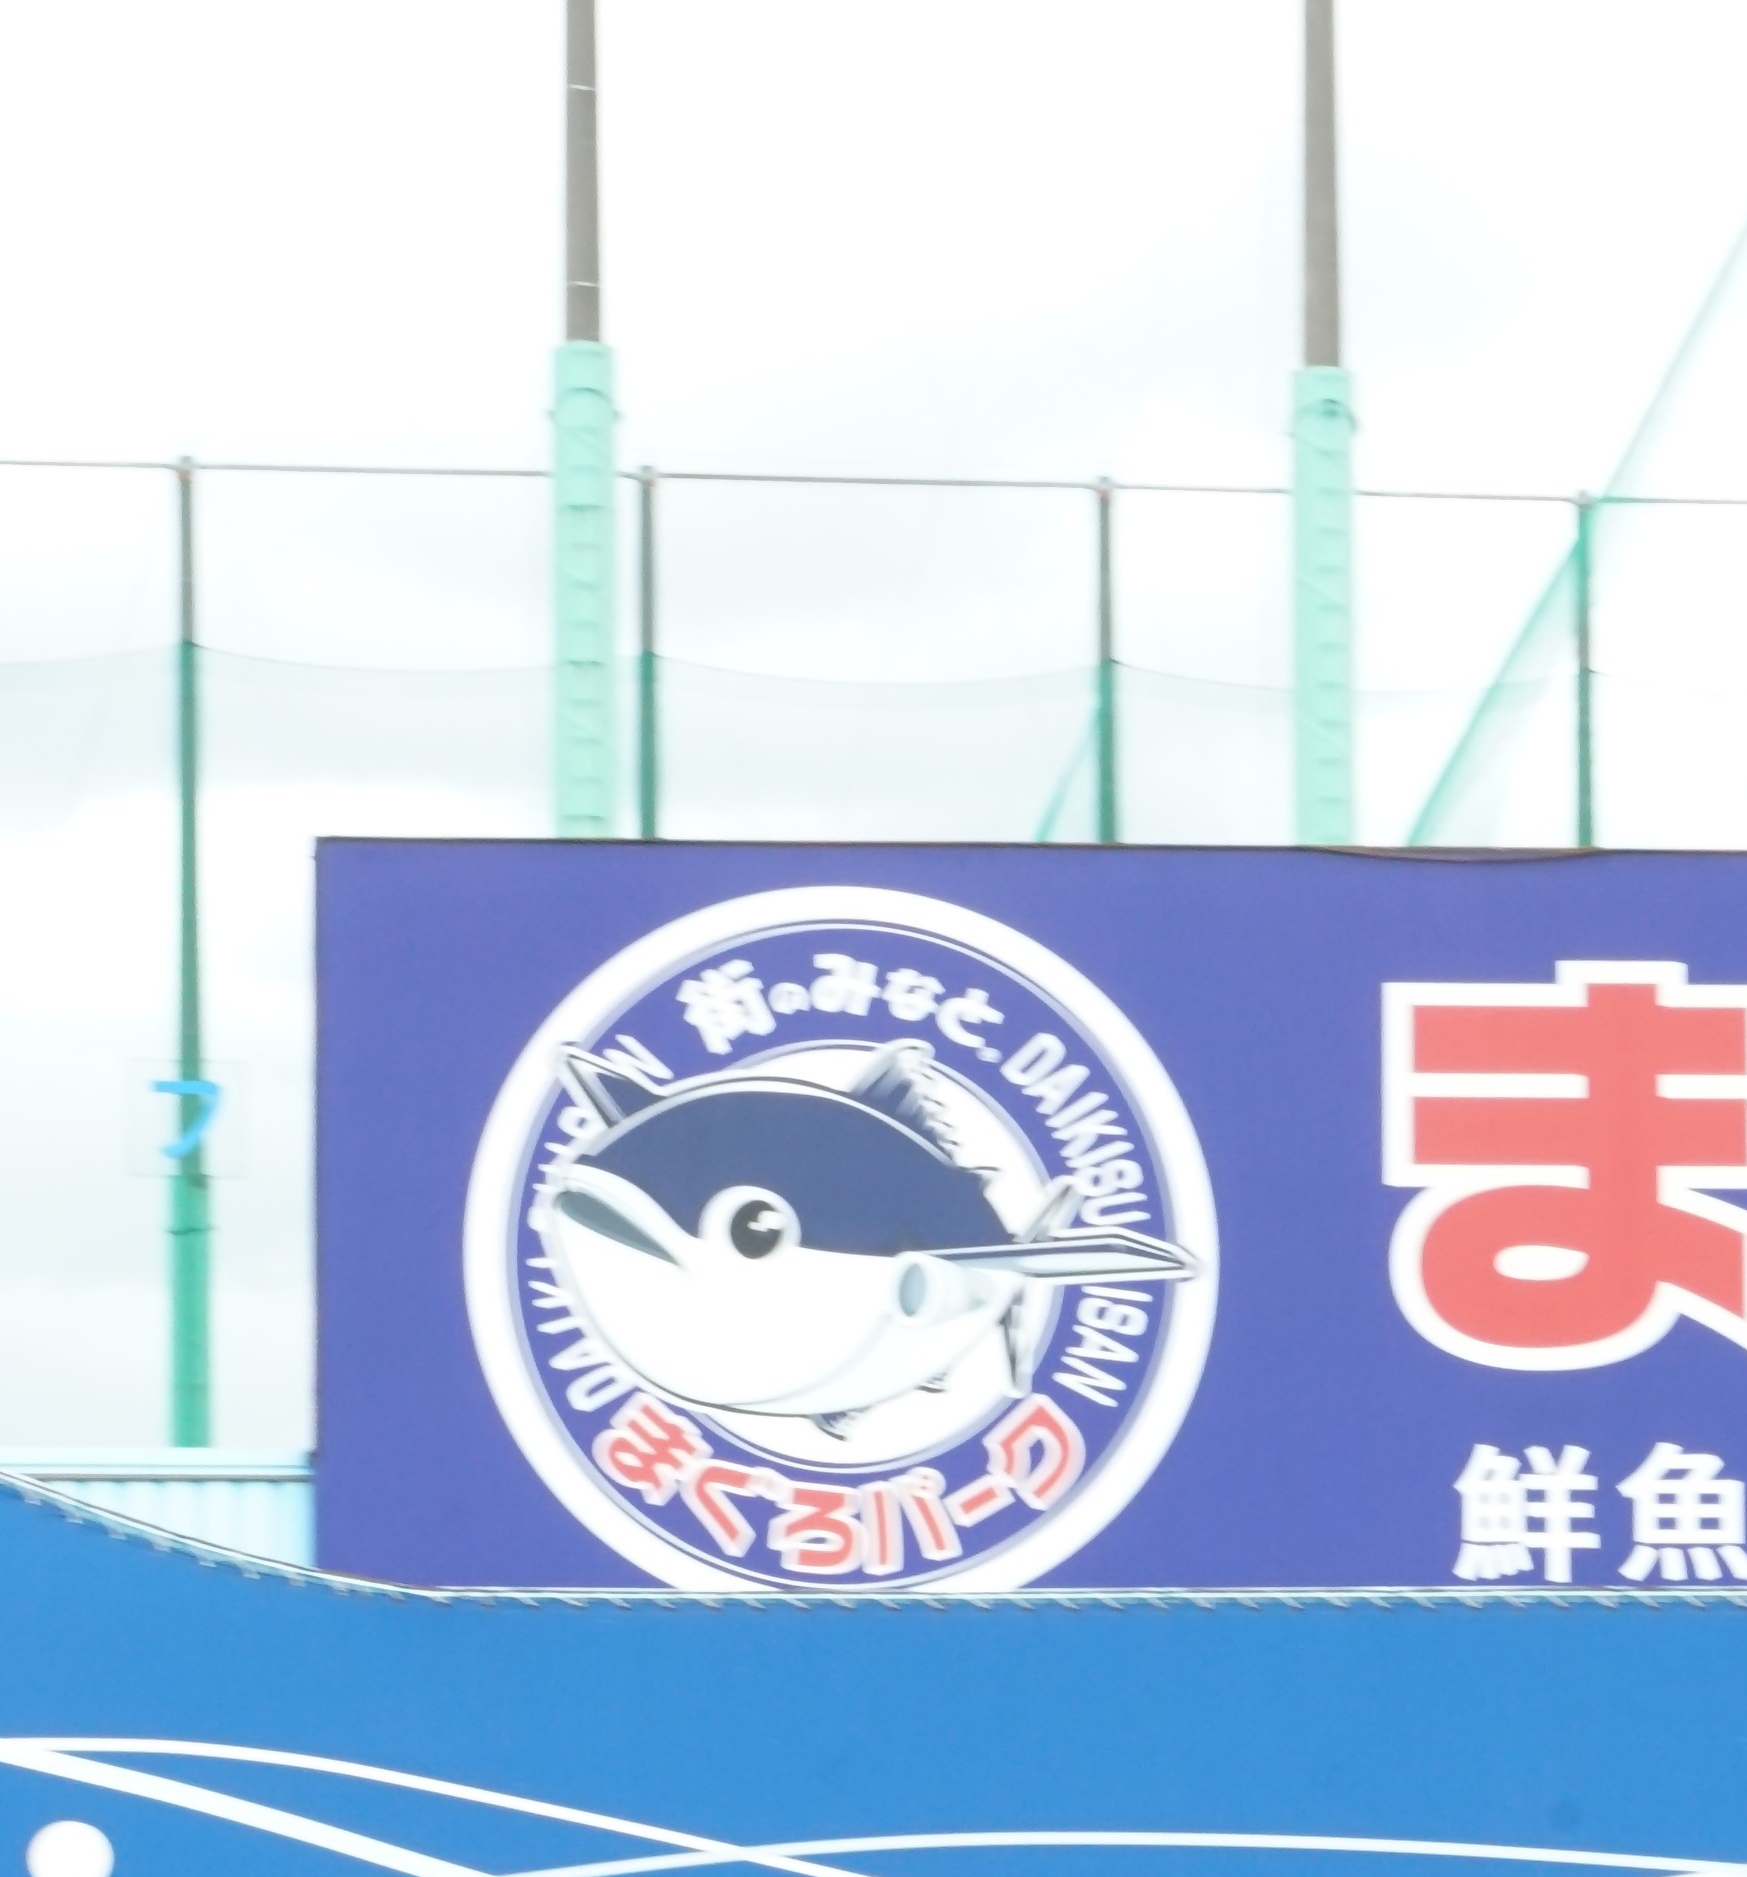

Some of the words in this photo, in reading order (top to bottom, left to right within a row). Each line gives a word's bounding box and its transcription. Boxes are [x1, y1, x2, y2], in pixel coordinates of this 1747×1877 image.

[593, 1394, 1086, 1576] まぐろパーク
